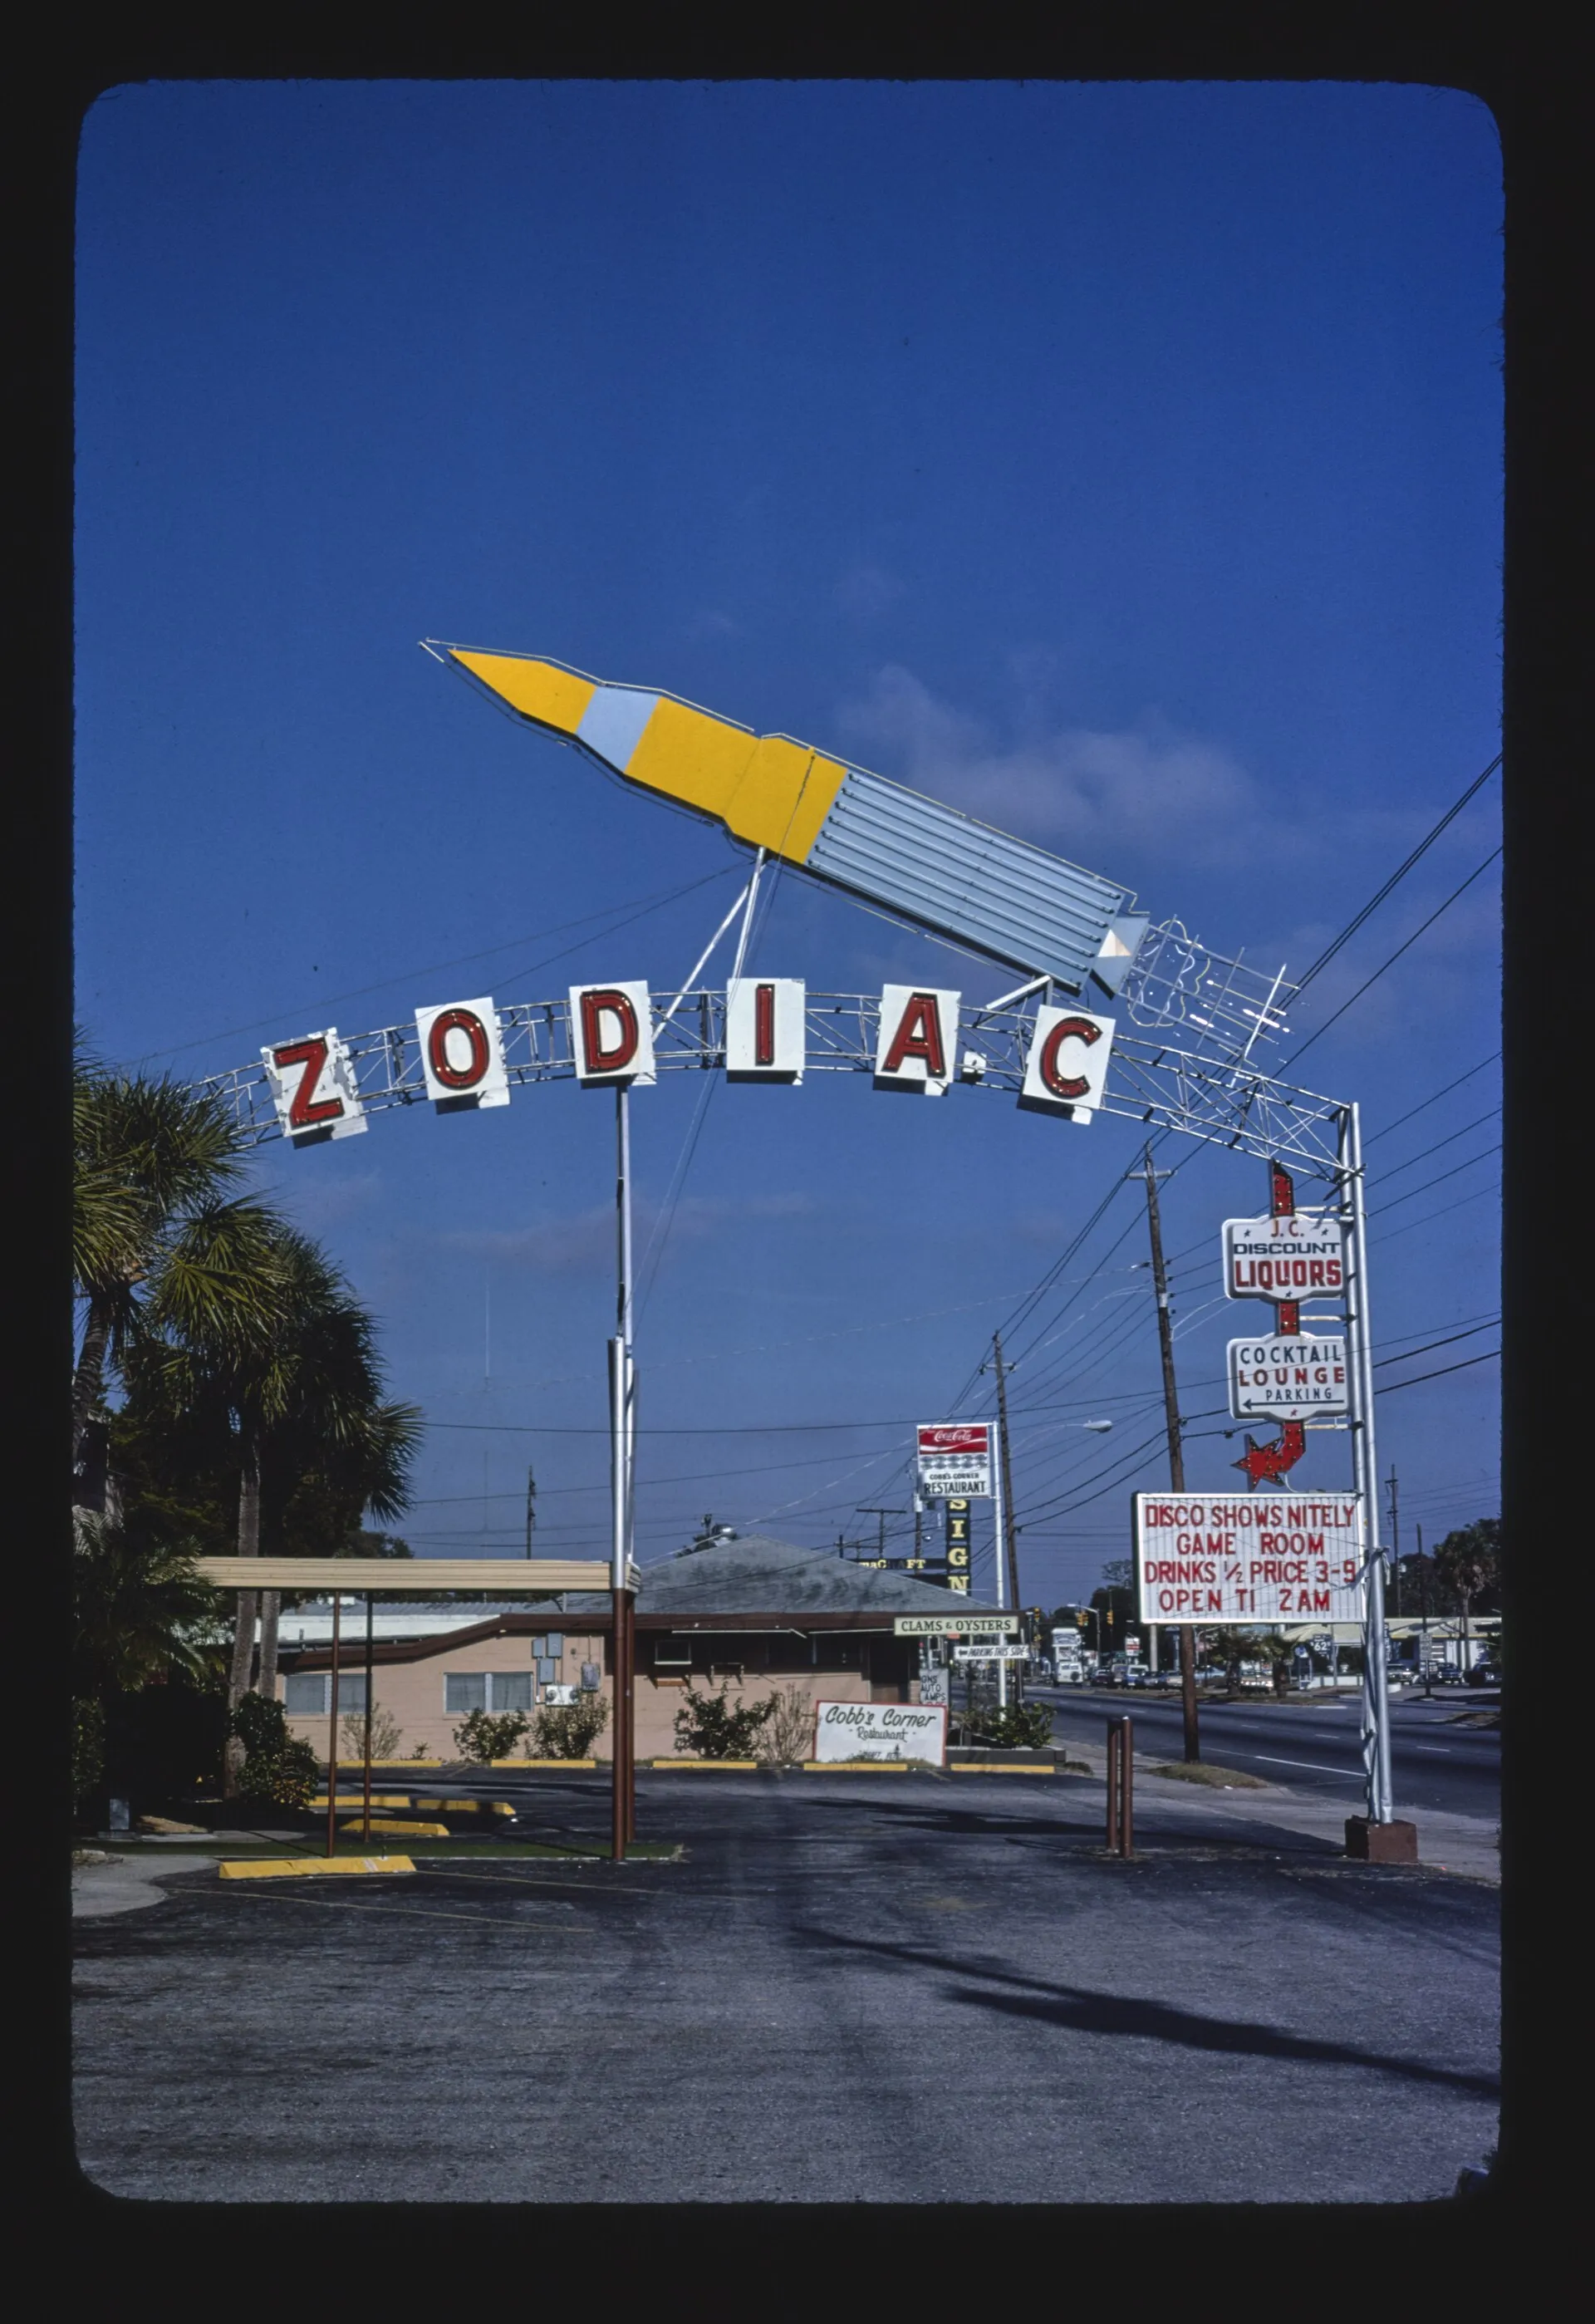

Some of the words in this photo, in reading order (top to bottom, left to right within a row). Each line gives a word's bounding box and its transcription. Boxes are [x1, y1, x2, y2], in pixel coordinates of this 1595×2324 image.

[273, 984, 1103, 1128] ZODIAC
[1234, 1243, 1339, 1254] DISCOUNT
[1235, 1260, 1341, 1290] LIQUORS
[1240, 1345, 1341, 1363] COCKTAIL
[1239, 1367, 1344, 1386] LOUNGE
[1266, 1388, 1332, 1400] PARKING
[925, 1481, 984, 1494] RESTAURANT
[1146, 1505, 1204, 1527] DISCO
[1211, 1505, 1282, 1527] SHOWS
[1288, 1505, 1354, 1527] NITELY
[1177, 1533, 1236, 1555] GAME
[1261, 1533, 1323, 1555] ROOM
[1145, 1561, 1216, 1584] DRINKS
[1250, 1561, 1308, 1583] PRICE
[1159, 1589, 1222, 1611] OPEN
[901, 1620, 942, 1631] CLAMS
[956, 1620, 1011, 1631] OYSTERS
[968, 1647, 994, 1657] PARKING
[1011, 1647, 1026, 1656] SIDE
[826, 1705, 875, 1726] Cobb's
[882, 1708, 936, 1727] Corner
